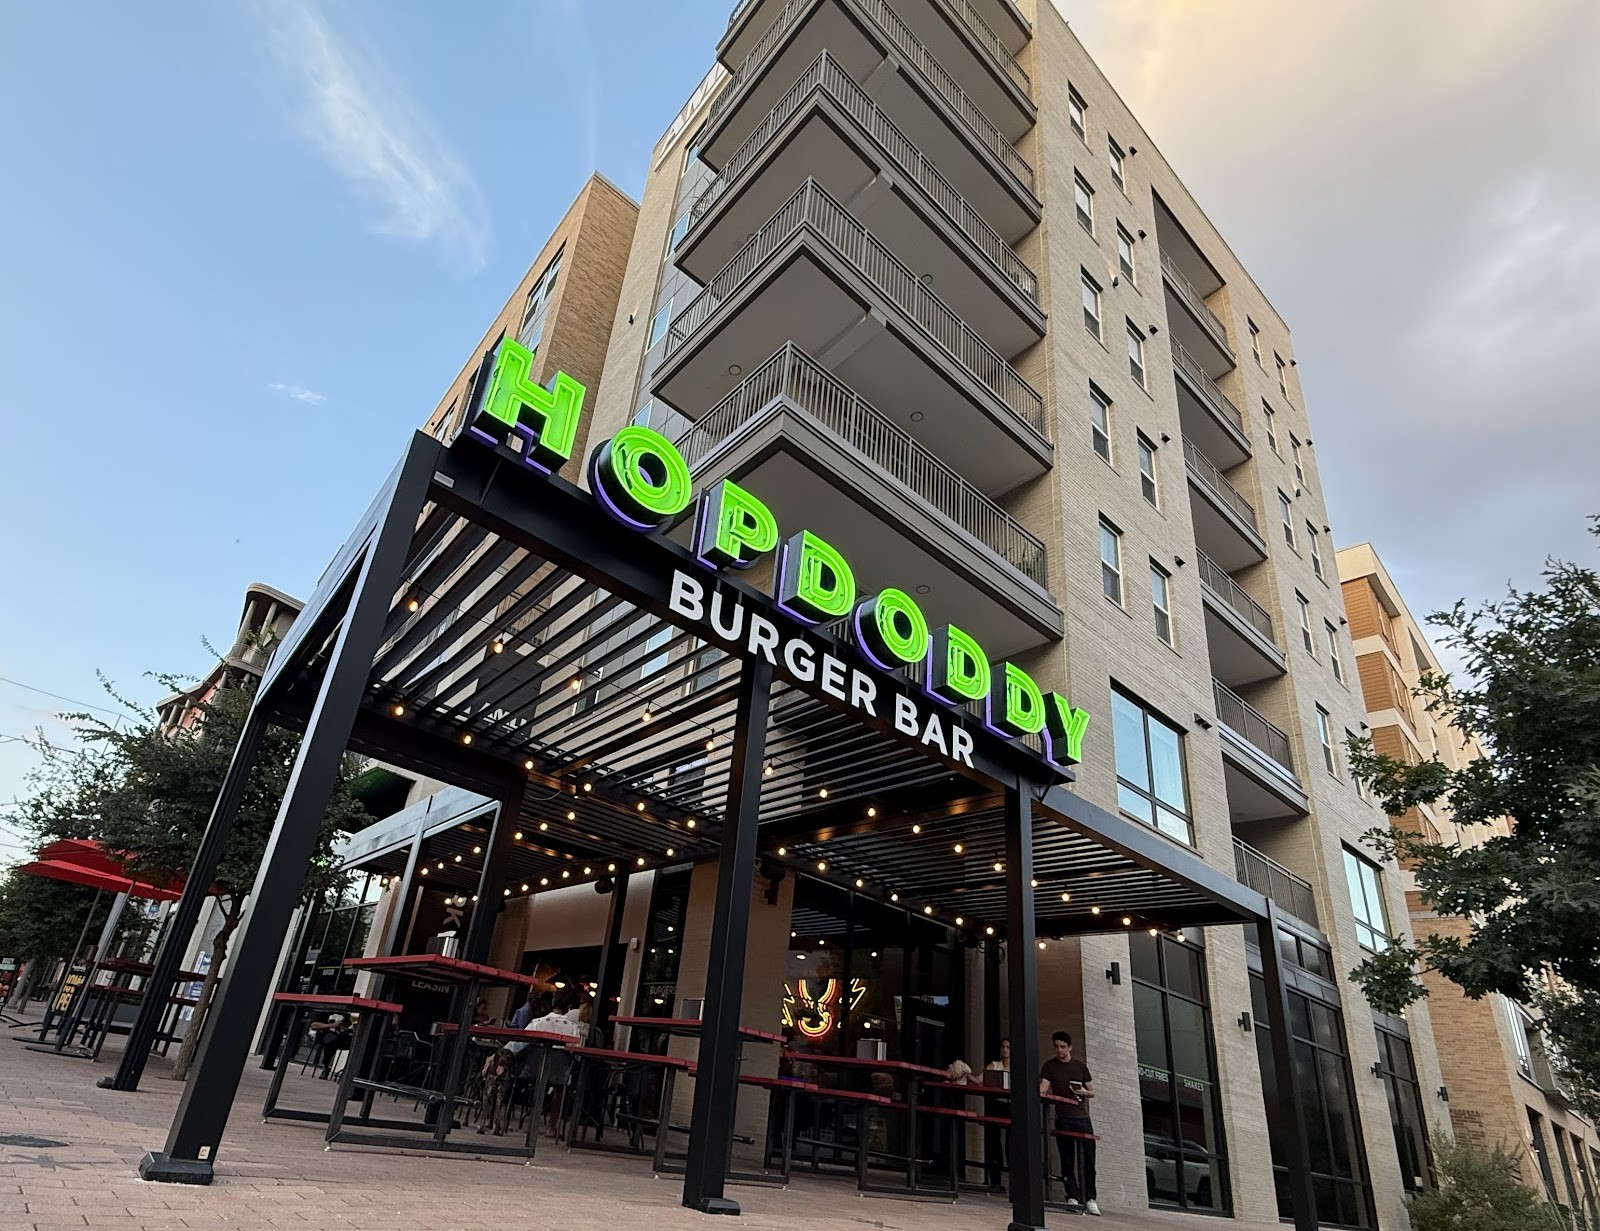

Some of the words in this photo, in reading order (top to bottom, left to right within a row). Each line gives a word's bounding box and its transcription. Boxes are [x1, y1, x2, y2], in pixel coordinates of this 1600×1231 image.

[472, 336, 1091, 764] HOPDODDY
[669, 569, 877, 717] BURGER
[894, 692, 974, 768] BAR
[1155, 1071, 1169, 1083] FRIES
[1183, 1078, 1204, 1092] SHAKES
